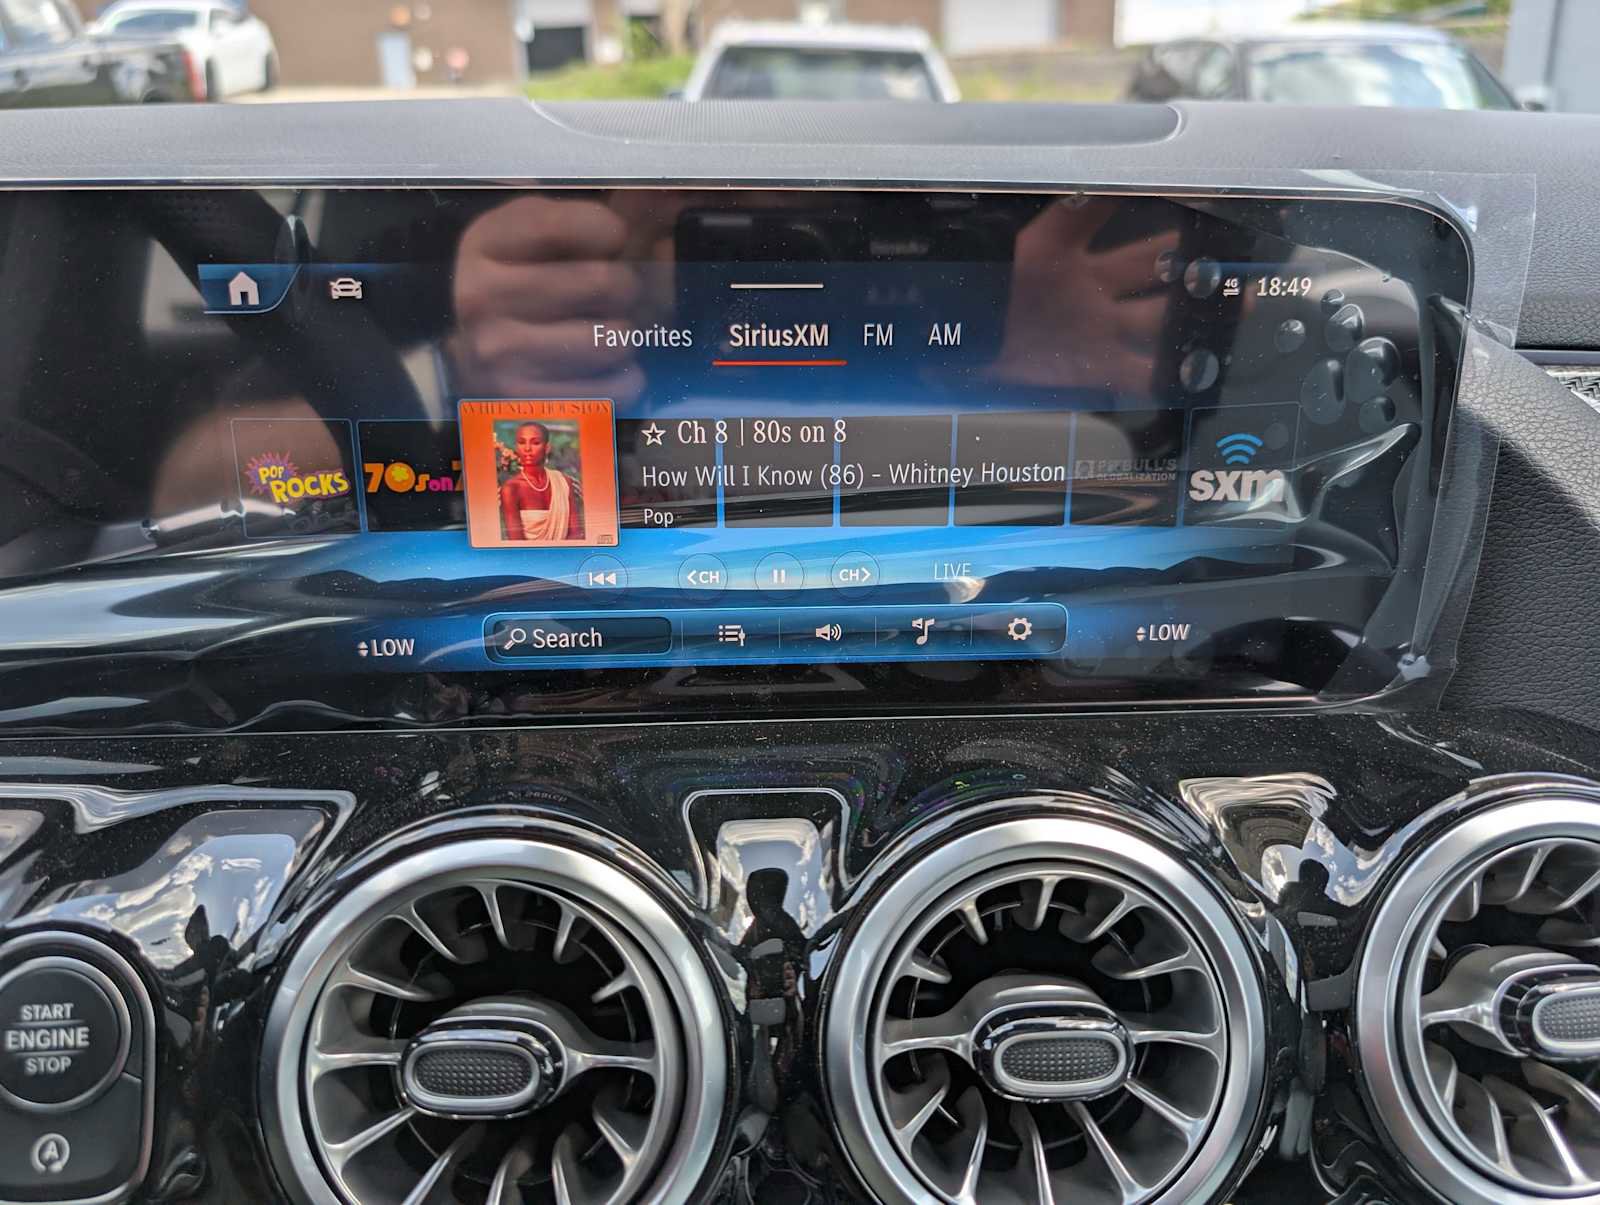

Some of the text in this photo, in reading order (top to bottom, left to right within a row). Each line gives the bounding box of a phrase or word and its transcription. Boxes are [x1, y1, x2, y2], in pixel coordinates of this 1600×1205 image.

[1257, 277, 1312, 297] 18:49
[593, 324, 693, 347] Favorites
[729, 323, 830, 347] SiriusXM
[863, 323, 894, 346] FM
[928, 322, 962, 345] AM
[677, 420, 706, 444] Ch
[715, 420, 728, 443] 8
[753, 420, 792, 444] 80s
[799, 423, 826, 443] on
[834, 419, 847, 442] 8
[259, 466, 285, 484] POP
[642, 465, 688, 488] How
[695, 465, 735, 487] Will
[742, 465, 750, 486] I
[758, 464, 813, 486] Know
[820, 462, 865, 490] (86)
[889, 461, 974, 488] Whitney
[981, 462, 1065, 483] Houston
[1188, 470, 1287, 503] sxm
[270, 472, 350, 504] ROCKS
[643, 508, 675, 528] Pop
[933, 562, 972, 581] LIVE
[532, 626, 603, 650] Search
[1149, 623, 1192, 643] LOW
[370, 638, 415, 658] LOW
[20, 1003, 75, 1021] START
[5, 1027, 91, 1050] ENGINE
[24, 1057, 73, 1076] STOP
